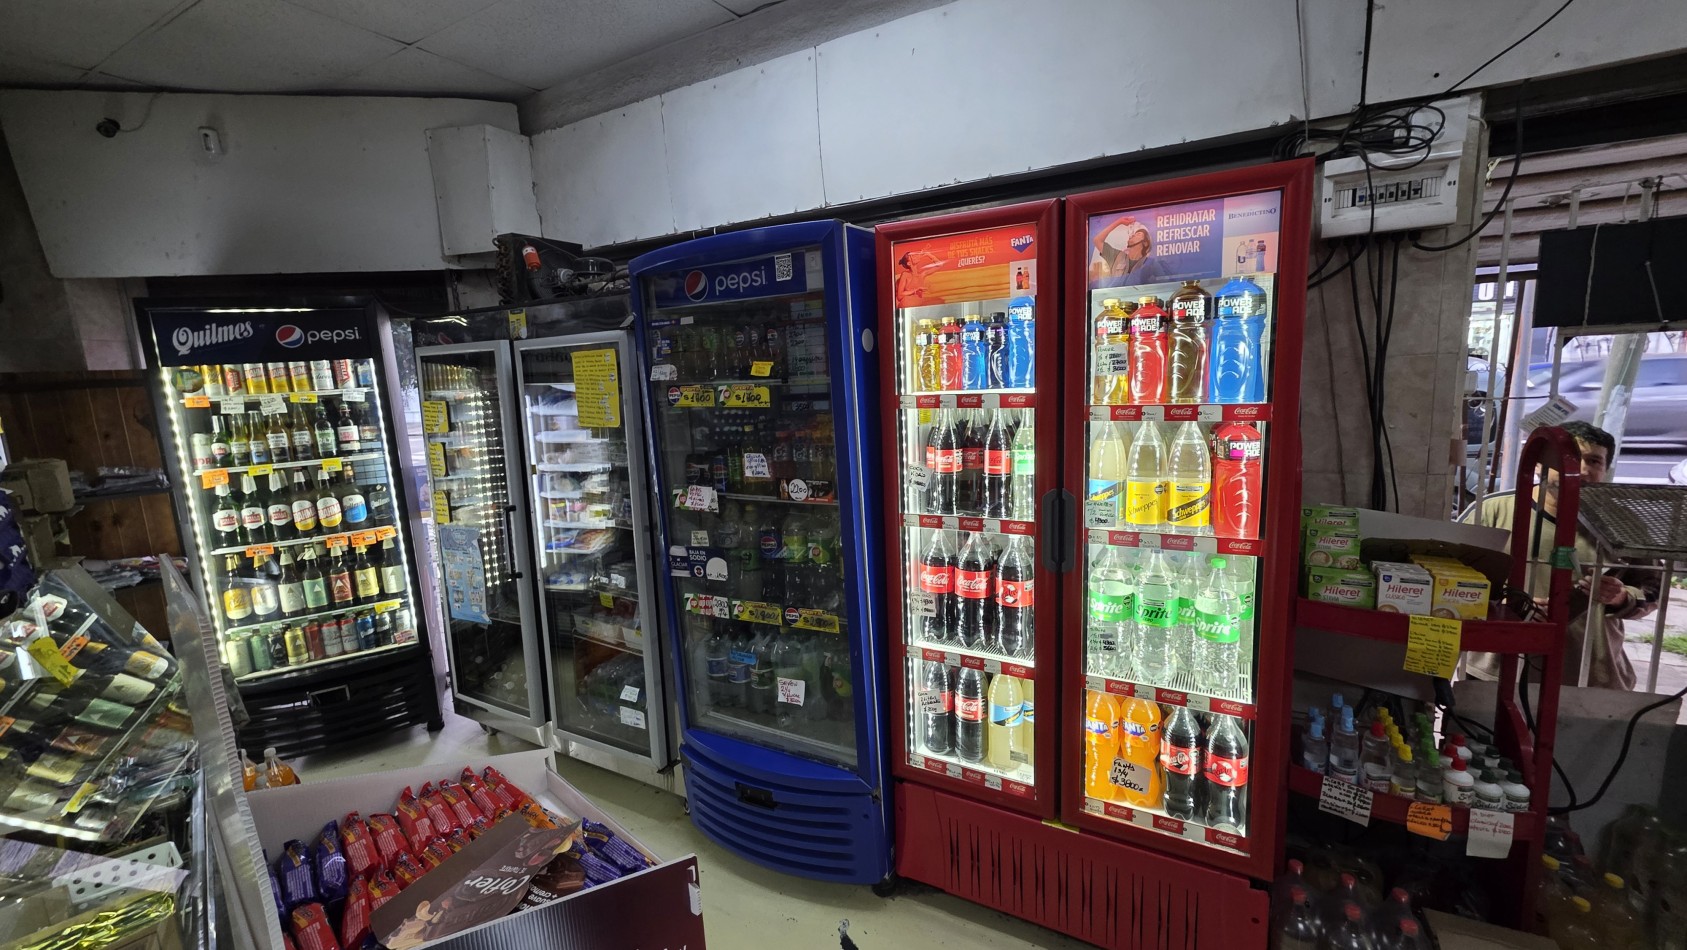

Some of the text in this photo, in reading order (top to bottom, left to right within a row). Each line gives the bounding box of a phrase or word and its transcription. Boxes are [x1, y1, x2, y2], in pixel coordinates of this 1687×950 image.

[1156, 209, 1216, 228] REHIDRATAR
[1228, 207, 1277, 220] BENEDICTINO
[1156, 225, 1210, 242] REFRESCAR
[979, 236, 993, 246] MÁS
[1010, 235, 1034, 246] FANTA
[1156, 241, 1200, 256] RENOVAR
[957, 256, 986, 268] ¿QUERÉS?
[715, 266, 767, 295] pepsi
[1172, 300, 1205, 311] POWER
[1218, 299, 1252, 308] POWER
[1097, 320, 1123, 328] POWER
[1131, 319, 1157, 327] POWER
[172, 321, 254, 356] Quilmes
[307, 327, 360, 345] pepsi
[1116, 408, 1136, 416] Coca-Cola
[1171, 407, 1193, 416] Coca-Cola
[1234, 406, 1259, 416] Coca-Cola
[1127, 499, 1158, 516] Schweppes
[1113, 534, 1134, 542] Coca-Cola
[1167, 538, 1189, 546] Coca-Cola
[1318, 537, 1349, 546] Hileret
[1229, 541, 1253, 550] Coca-Cola
[920, 571, 949, 585] Coca-Cola
[957, 576, 988, 590] Coca-Cola
[1324, 585, 1361, 597] Hileret
[1387, 584, 1424, 596] Hileret
[1443, 588, 1482, 600] Hileret
[1090, 597, 1123, 614] Sprite
[1135, 604, 1172, 620] Sprite
[1195, 616, 1232, 635] Sprite
[1110, 682, 1130, 691] Coca-Cola
[1161, 691, 1183, 701] Coca-Cola
[1220, 701, 1243, 712] Coca-Cola
[1108, 805, 1129, 816] Coca-Cola
[1158, 818, 1179, 828] Coca-Cola
[1215, 833, 1238, 844] Coca-Cola
[463, 873, 531, 897] Cofler
